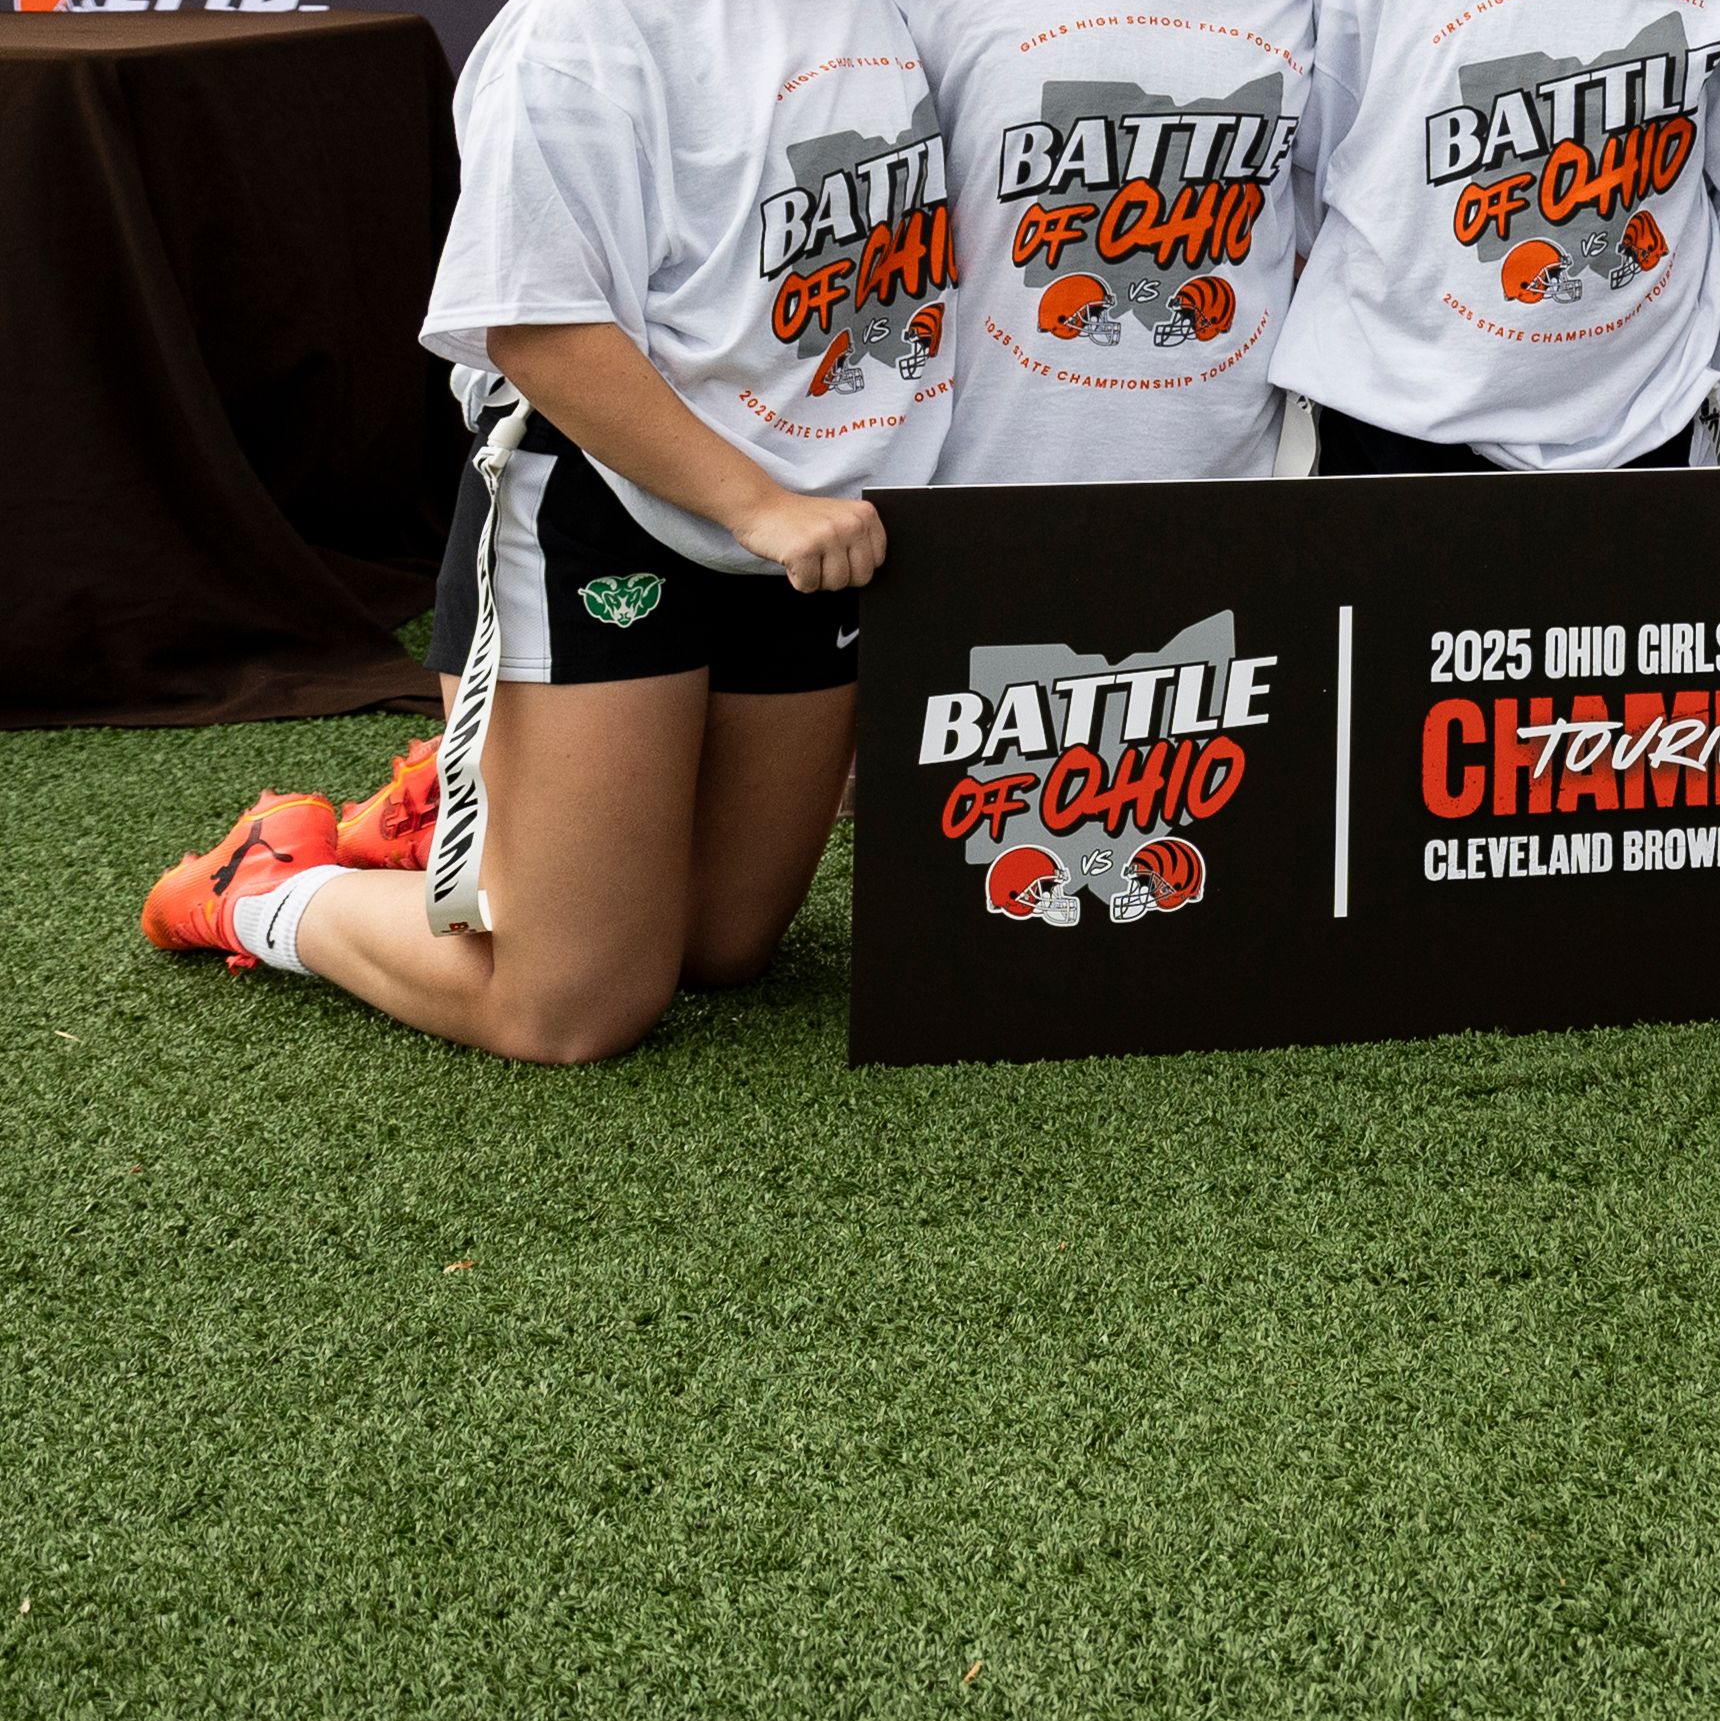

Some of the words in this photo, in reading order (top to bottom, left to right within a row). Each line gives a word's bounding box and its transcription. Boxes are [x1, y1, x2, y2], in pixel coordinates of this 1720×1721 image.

[1020, 24, 1068, 54] GIRLS
[1076, 15, 1118, 30] HIGH
[1126, 15, 1192, 30] SCHOOL
[1200, 23, 1239, 37] FLAG
[1432, 11, 1472, 44] GIRLS
[997, 113, 1299, 204] BATTLE
[1453, 173, 1535, 247] OF
[1538, 115, 1697, 226] OHIO
[1011, 202, 1099, 270] OF
[1095, 176, 1266, 270] OHIO
[772, 258, 855, 345] OF
[1443, 292, 1474, 321] 2025
[1476, 318, 1524, 342] STATE
[1531, 303, 1643, 344] CHAMPIONSHIP
[1012, 344, 1051, 377] STATE
[1057, 369, 1193, 390] CHAMPIONSHIP
[1201, 309, 1270, 383] TOURNAMENT
[1431, 629, 1532, 683] 2025
[1544, 624, 1623, 679] OHIO
[919, 655, 1277, 765] BATTLE
[942, 773, 1040, 839] OF
[1040, 735, 1245, 831] OHIO
[1423, 832, 1614, 882] CLEVELAND
